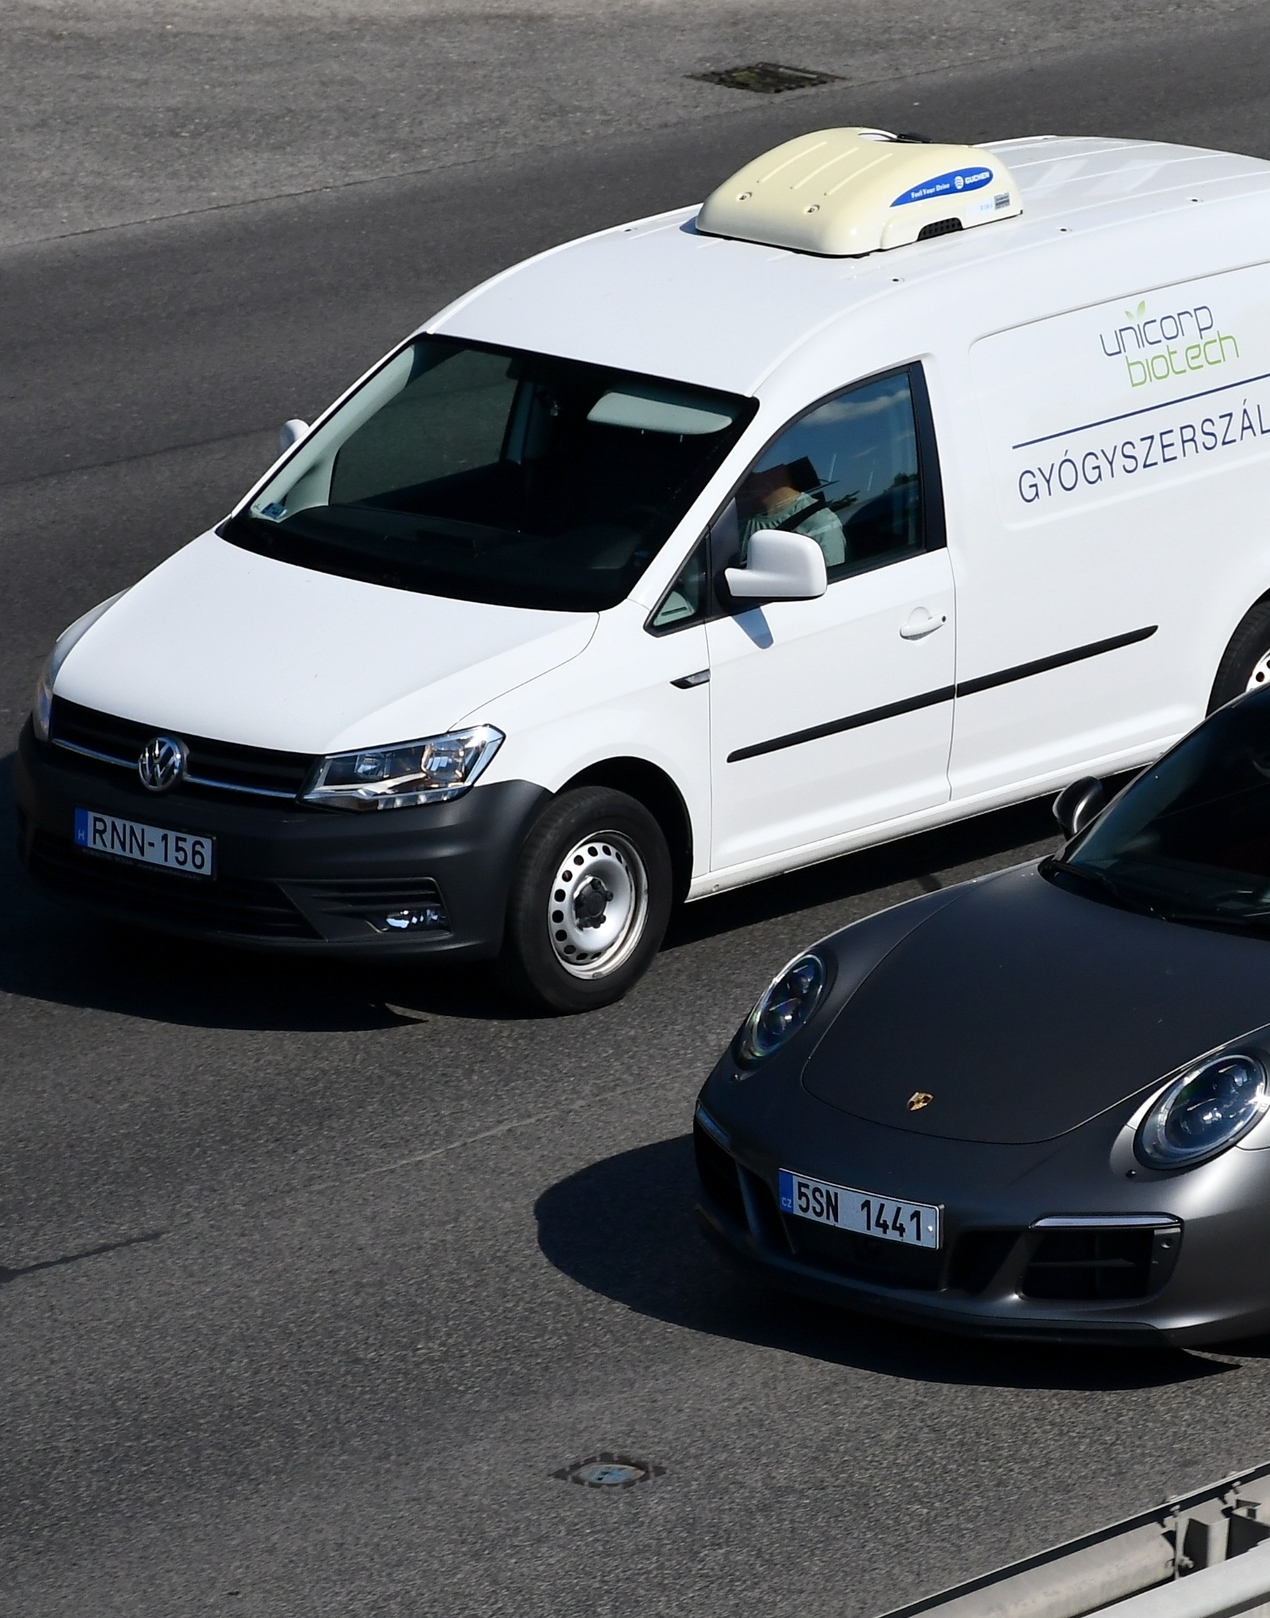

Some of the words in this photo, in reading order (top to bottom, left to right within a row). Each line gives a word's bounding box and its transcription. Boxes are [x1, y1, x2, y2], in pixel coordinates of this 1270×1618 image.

[1099, 305, 1215, 357] unicorp
[1125, 330, 1240, 388] biotech
[77, 829, 85, 841] H
[92, 815, 206, 870] RNN-156
[781, 1197, 792, 1208] CZ
[797, 1181, 839, 1223] 5SN
[860, 1199, 922, 1242] 1441
